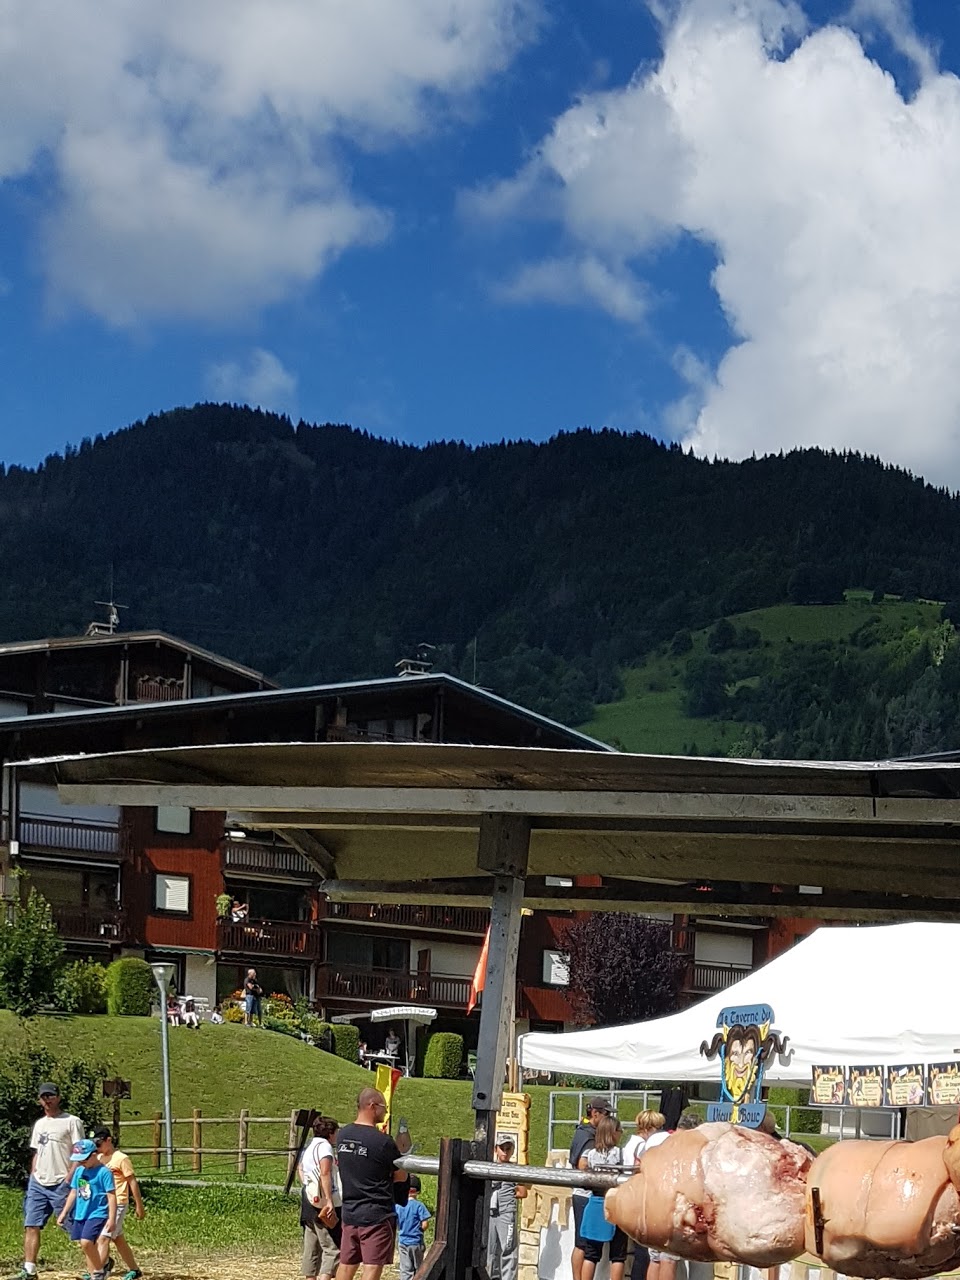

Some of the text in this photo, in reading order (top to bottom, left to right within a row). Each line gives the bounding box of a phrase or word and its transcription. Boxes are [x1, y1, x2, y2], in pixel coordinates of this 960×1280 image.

[730, 1011, 759, 1024] Taverne
[761, 1008, 771, 1022] du
[740, 1107, 760, 1122] Bouc
